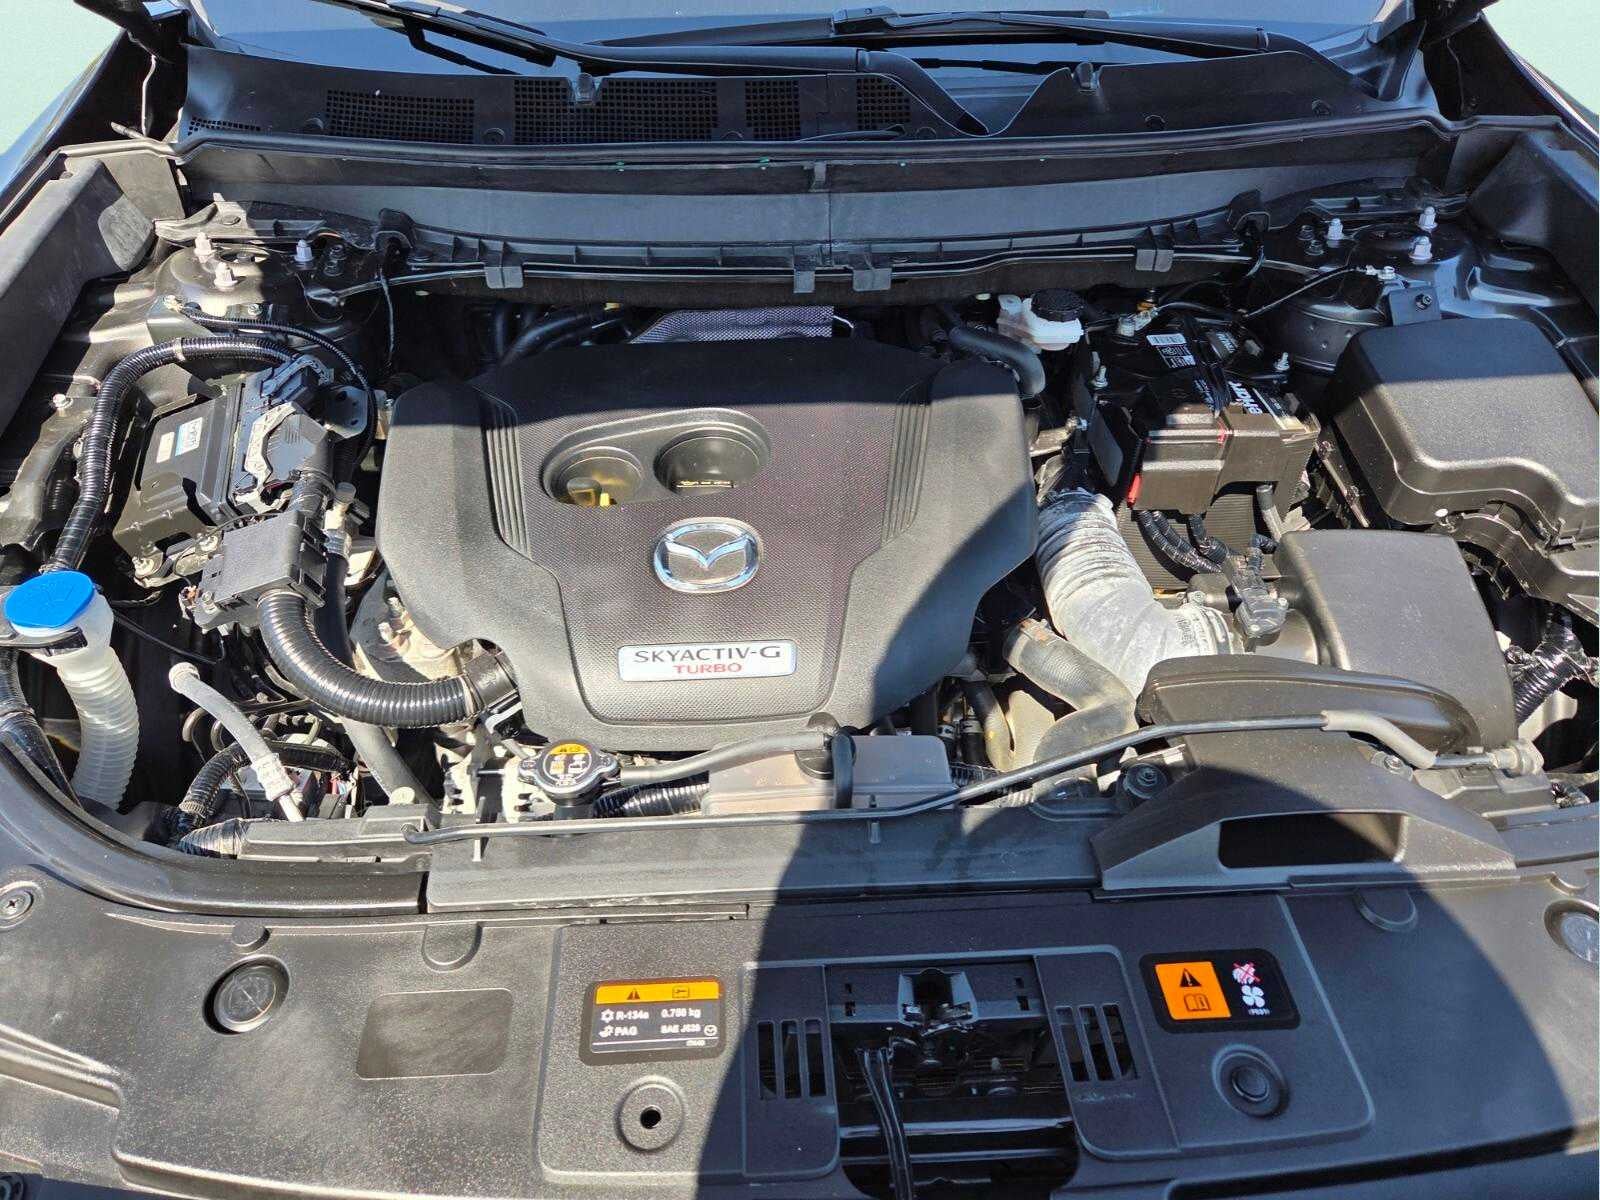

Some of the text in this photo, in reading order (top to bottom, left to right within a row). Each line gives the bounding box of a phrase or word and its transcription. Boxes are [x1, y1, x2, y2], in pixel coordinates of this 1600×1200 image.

[634, 645, 781, 663] SKYACTIV-G
[673, 663, 742, 674] TURBO
[616, 1010, 650, 1020] R-134a
[614, 1026, 638, 1036] PAG
